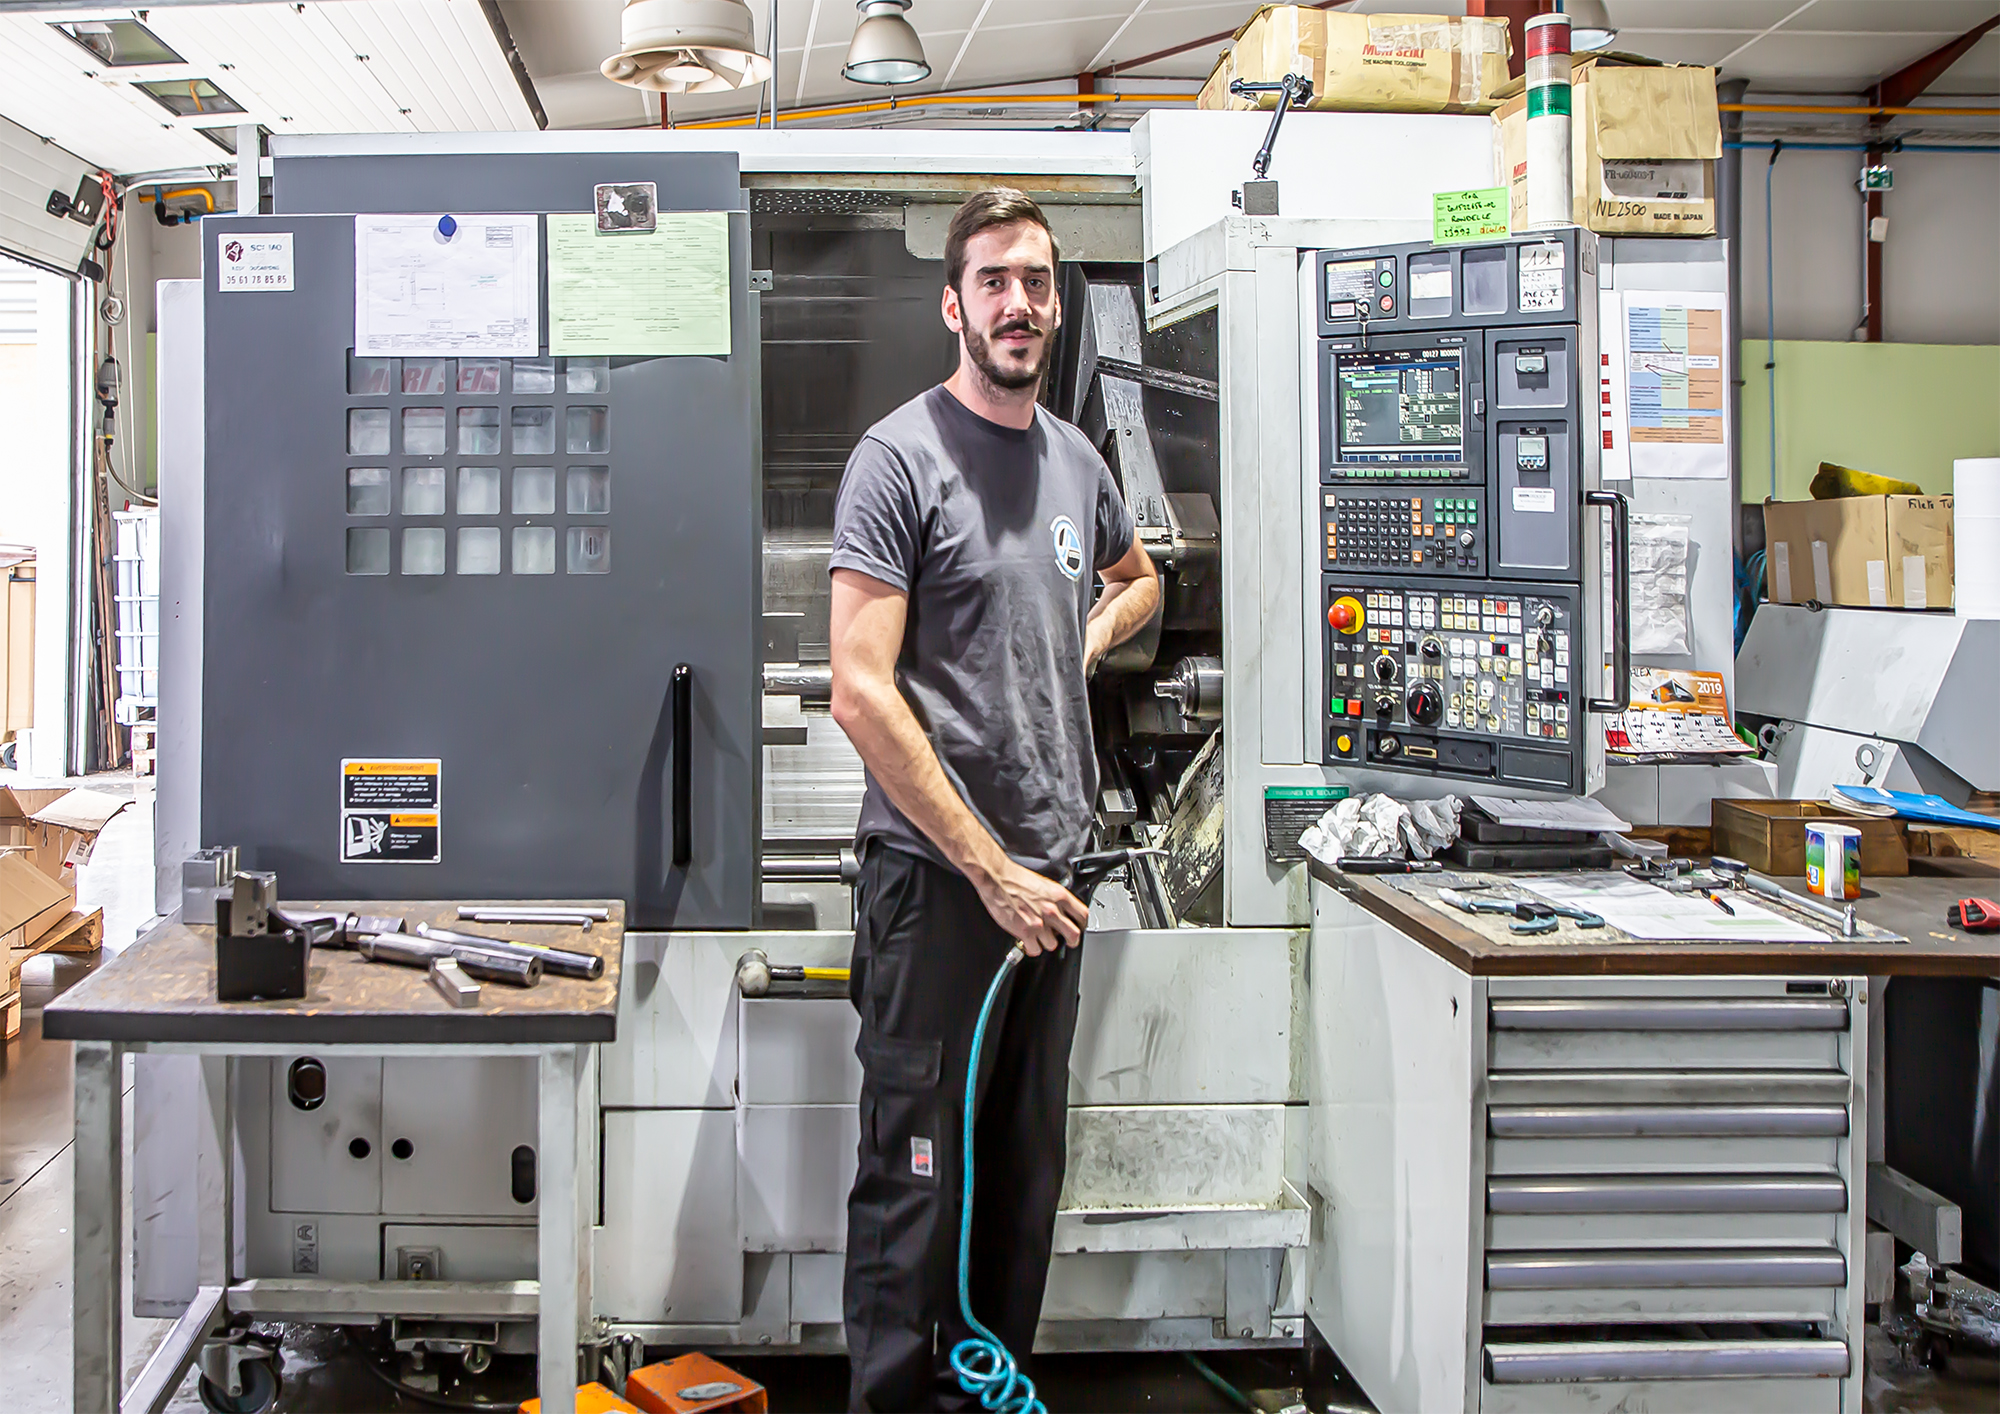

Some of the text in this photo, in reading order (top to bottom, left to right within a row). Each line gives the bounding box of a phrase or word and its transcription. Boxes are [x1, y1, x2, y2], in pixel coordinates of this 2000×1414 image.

[1596, 198, 1647, 217] NL2500
[239, 275, 248, 284] 61
[252, 275, 261, 284] 78
[264, 275, 275, 284] 85
[277, 274, 287, 284] 85
[1697, 681, 1723, 695] 2019
